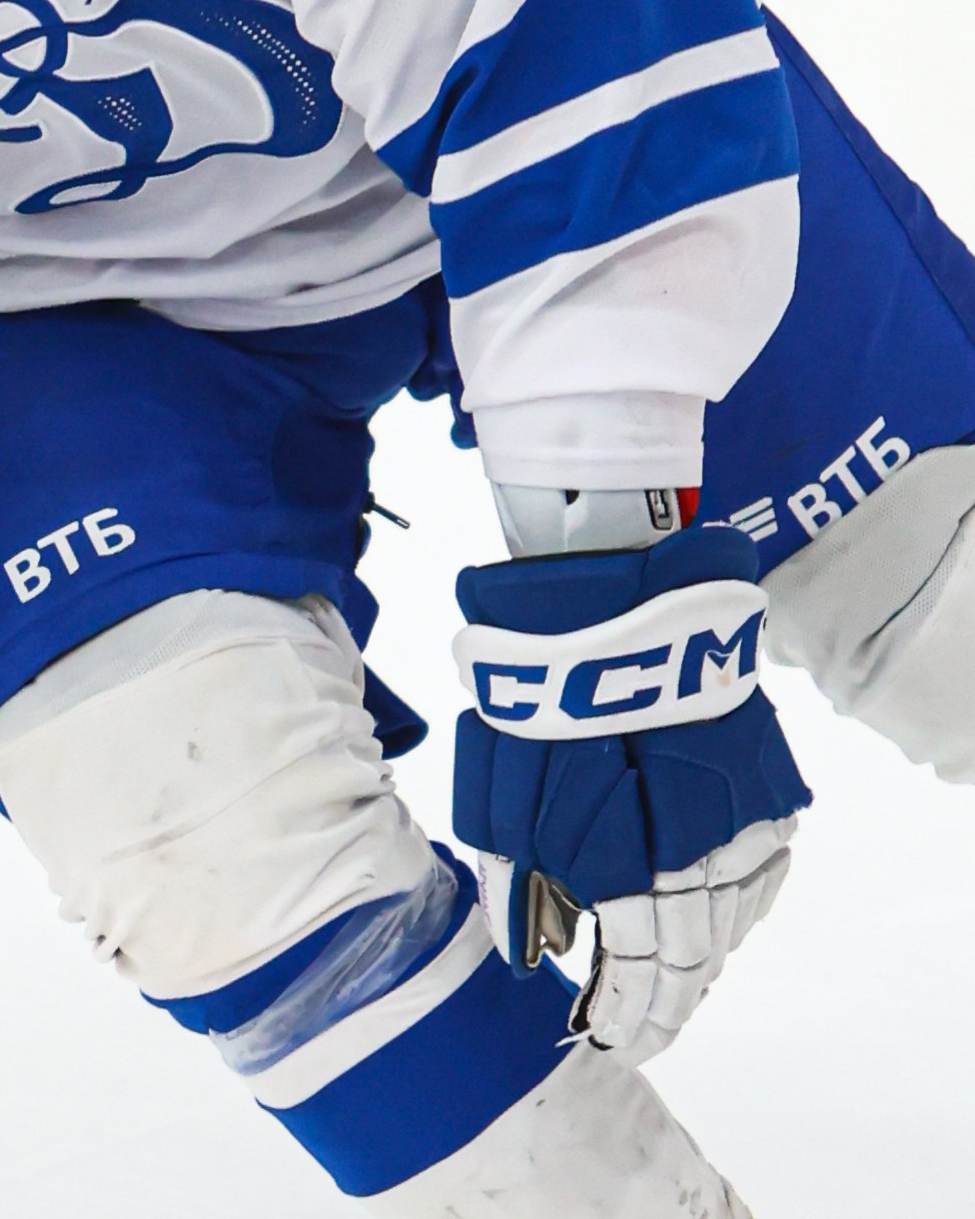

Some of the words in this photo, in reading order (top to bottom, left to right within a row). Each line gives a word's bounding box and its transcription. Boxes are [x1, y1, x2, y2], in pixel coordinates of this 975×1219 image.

[787, 415, 912, 540] ВТБ
[3, 507, 136, 604] ВТБ
[472, 608, 766, 722] CCM
